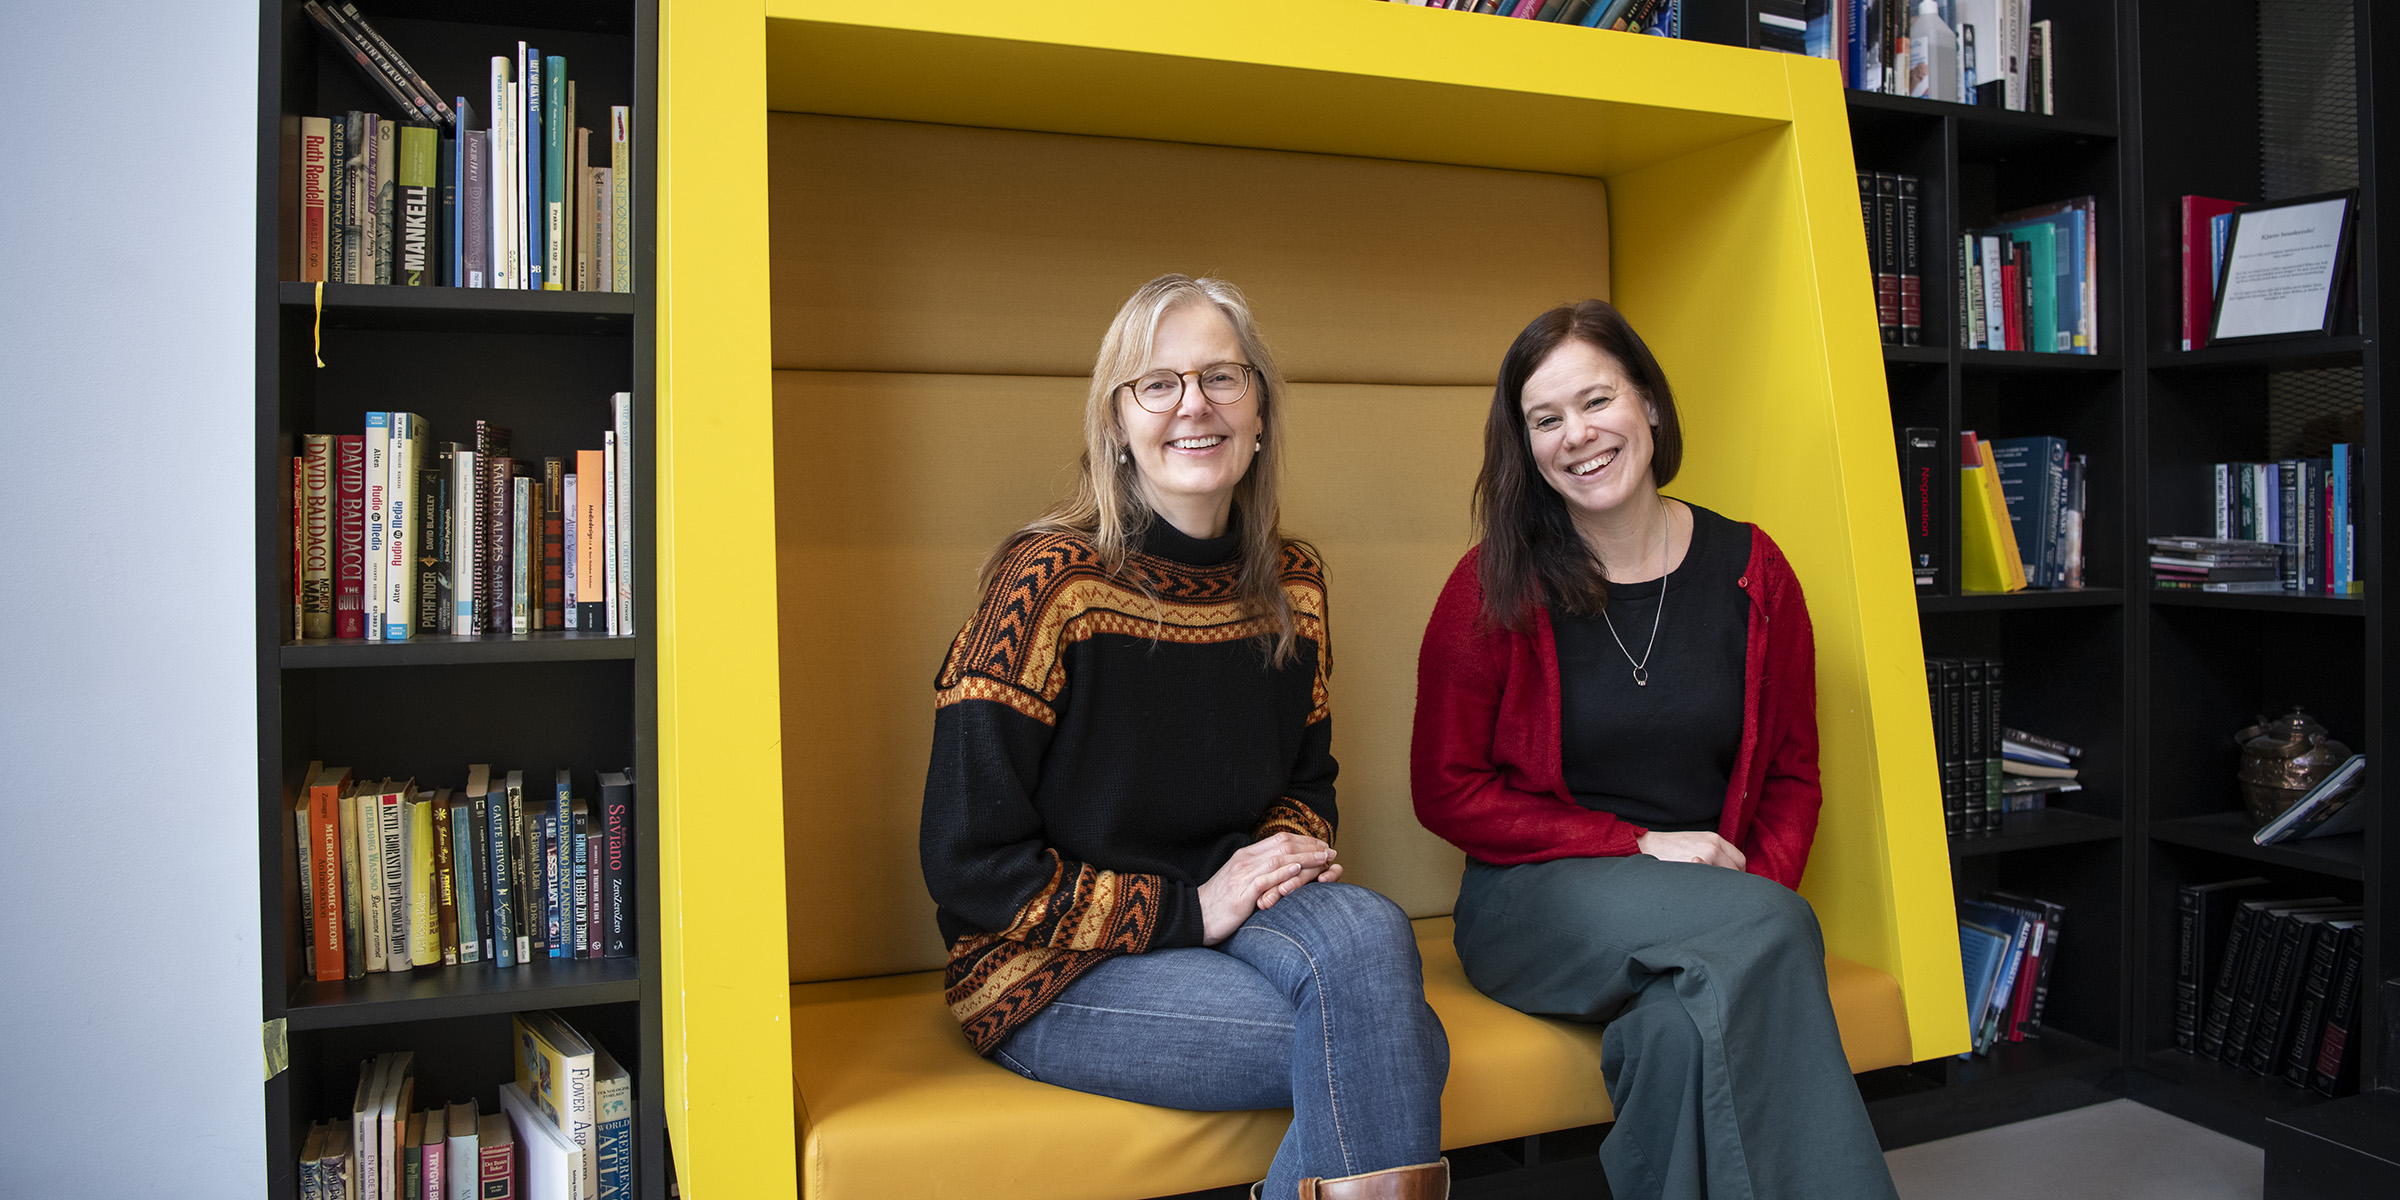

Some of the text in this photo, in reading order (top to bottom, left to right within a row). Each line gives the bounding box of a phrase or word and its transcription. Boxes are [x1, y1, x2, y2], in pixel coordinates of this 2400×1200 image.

[355, 35, 406, 87] SAINT MAUD
[361, 21, 412, 75] MILLION DOLLAR BABY
[333, 123, 344, 156] SIGURD
[306, 136, 325, 205] Ruth Rendell
[405, 186, 427, 271] MANKELL
[1885, 202, 1894, 266] Britannica
[1907, 205, 1917, 268] Britannica
[373, 448, 381, 468] Alten
[307, 442, 327, 572] DAVID BALDACCI
[341, 442, 363, 580] DAVID BALDACCI
[371, 485, 383, 551] Audio Media
[426, 494, 435, 550] DAVID BLAKELEY
[1920, 467, 1930, 536] Negotiation
[391, 501, 404, 566] Audio Media
[492, 463, 503, 608] KARSTEN ALNÆS SABINA
[305, 580, 319, 613] MAN
[319, 578, 330, 614] MEMORY
[338, 595, 364, 610] GUILTY
[423, 572, 436, 628] PATHFINDER
[1951, 692, 1960, 755] Britannica
[1971, 691, 1980, 753] Britannica
[1992, 690, 2001, 751] Britannica
[383, 805, 399, 832] KETIL
[559, 791, 569, 823] SIGURD
[365, 806, 379, 891] HERBJØRG WASSMO
[385, 834, 401, 879] BJØRNSTAD
[493, 805, 505, 884] GAUTE HEIVOLL
[530, 832, 543, 862] BETRAYAL
[575, 834, 586, 877] FØR STORMEN
[608, 805, 625, 871] Saviano
[318, 859, 327, 918] An Introduction
[325, 824, 338, 951] MICROECONOMIC THEORY
[532, 870, 544, 890] DEATH
[547, 854, 558, 908] LIMITLESS
[612, 879, 623, 933] ZeroZeroZero
[575, 880, 587, 950] MICHAEL KATZ KREFELD
[2181, 917, 2192, 976] Britannica
[2220, 931, 2242, 987] Britannica
[2243, 939, 2266, 995] Britannica
[2270, 944, 2292, 1001] Britannica
[2335, 958, 2358, 1019] Britannica
[2292, 1001, 2314, 1060] Britannica
[571, 1068, 590, 1112] FLOWER
[597, 1119, 630, 1131] WORLD
[368, 1155, 375, 1165] EN
[407, 1163, 418, 1174] Per
[429, 1152, 439, 1190] TRYGVE
